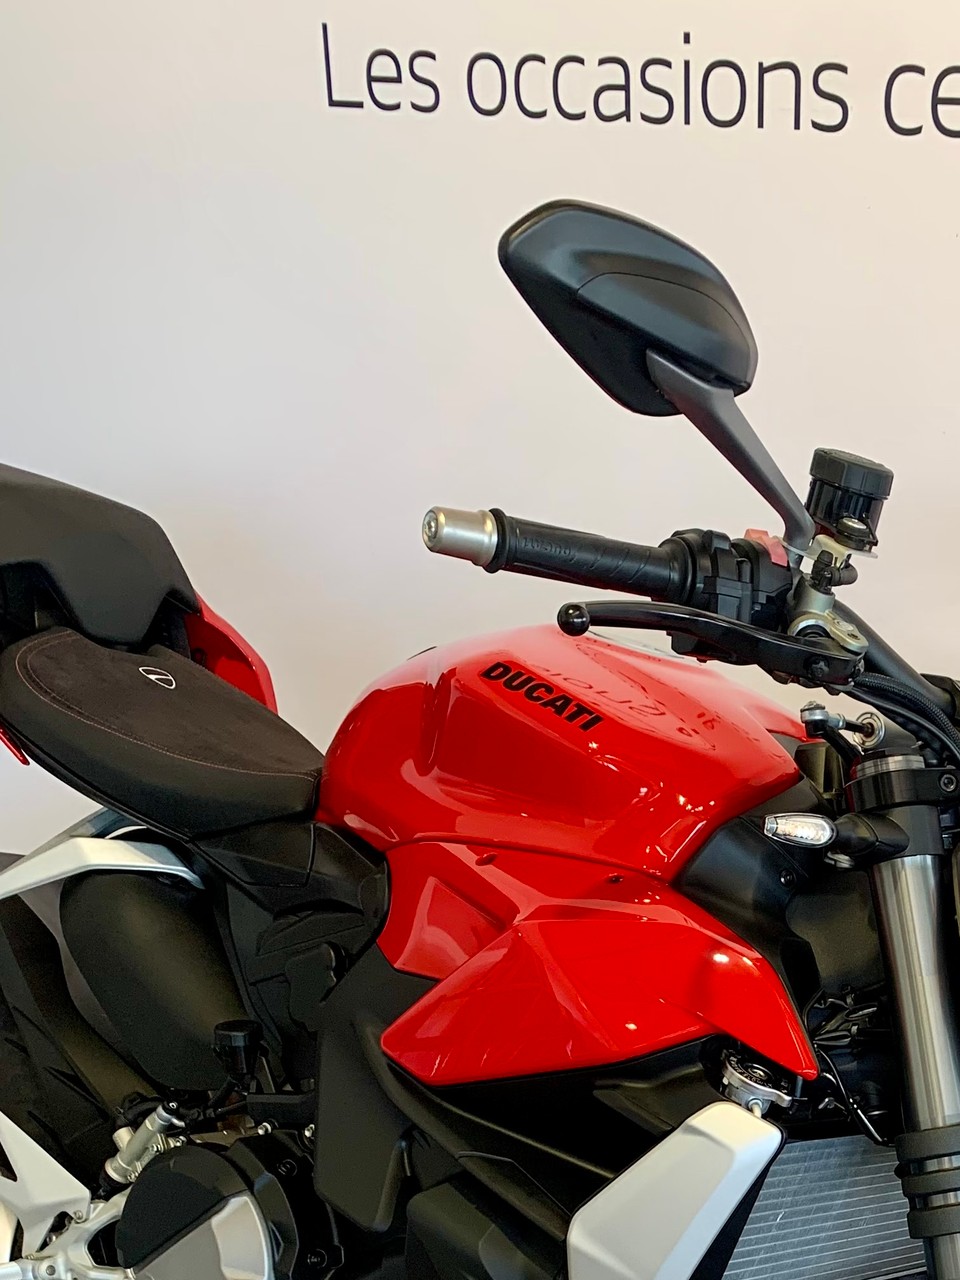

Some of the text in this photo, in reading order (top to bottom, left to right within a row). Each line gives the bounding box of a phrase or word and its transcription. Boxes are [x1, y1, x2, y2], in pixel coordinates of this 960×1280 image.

[321, 22, 440, 114] Les
[466, 31, 849, 133] occasions
[480, 661, 604, 732] DUCATI
